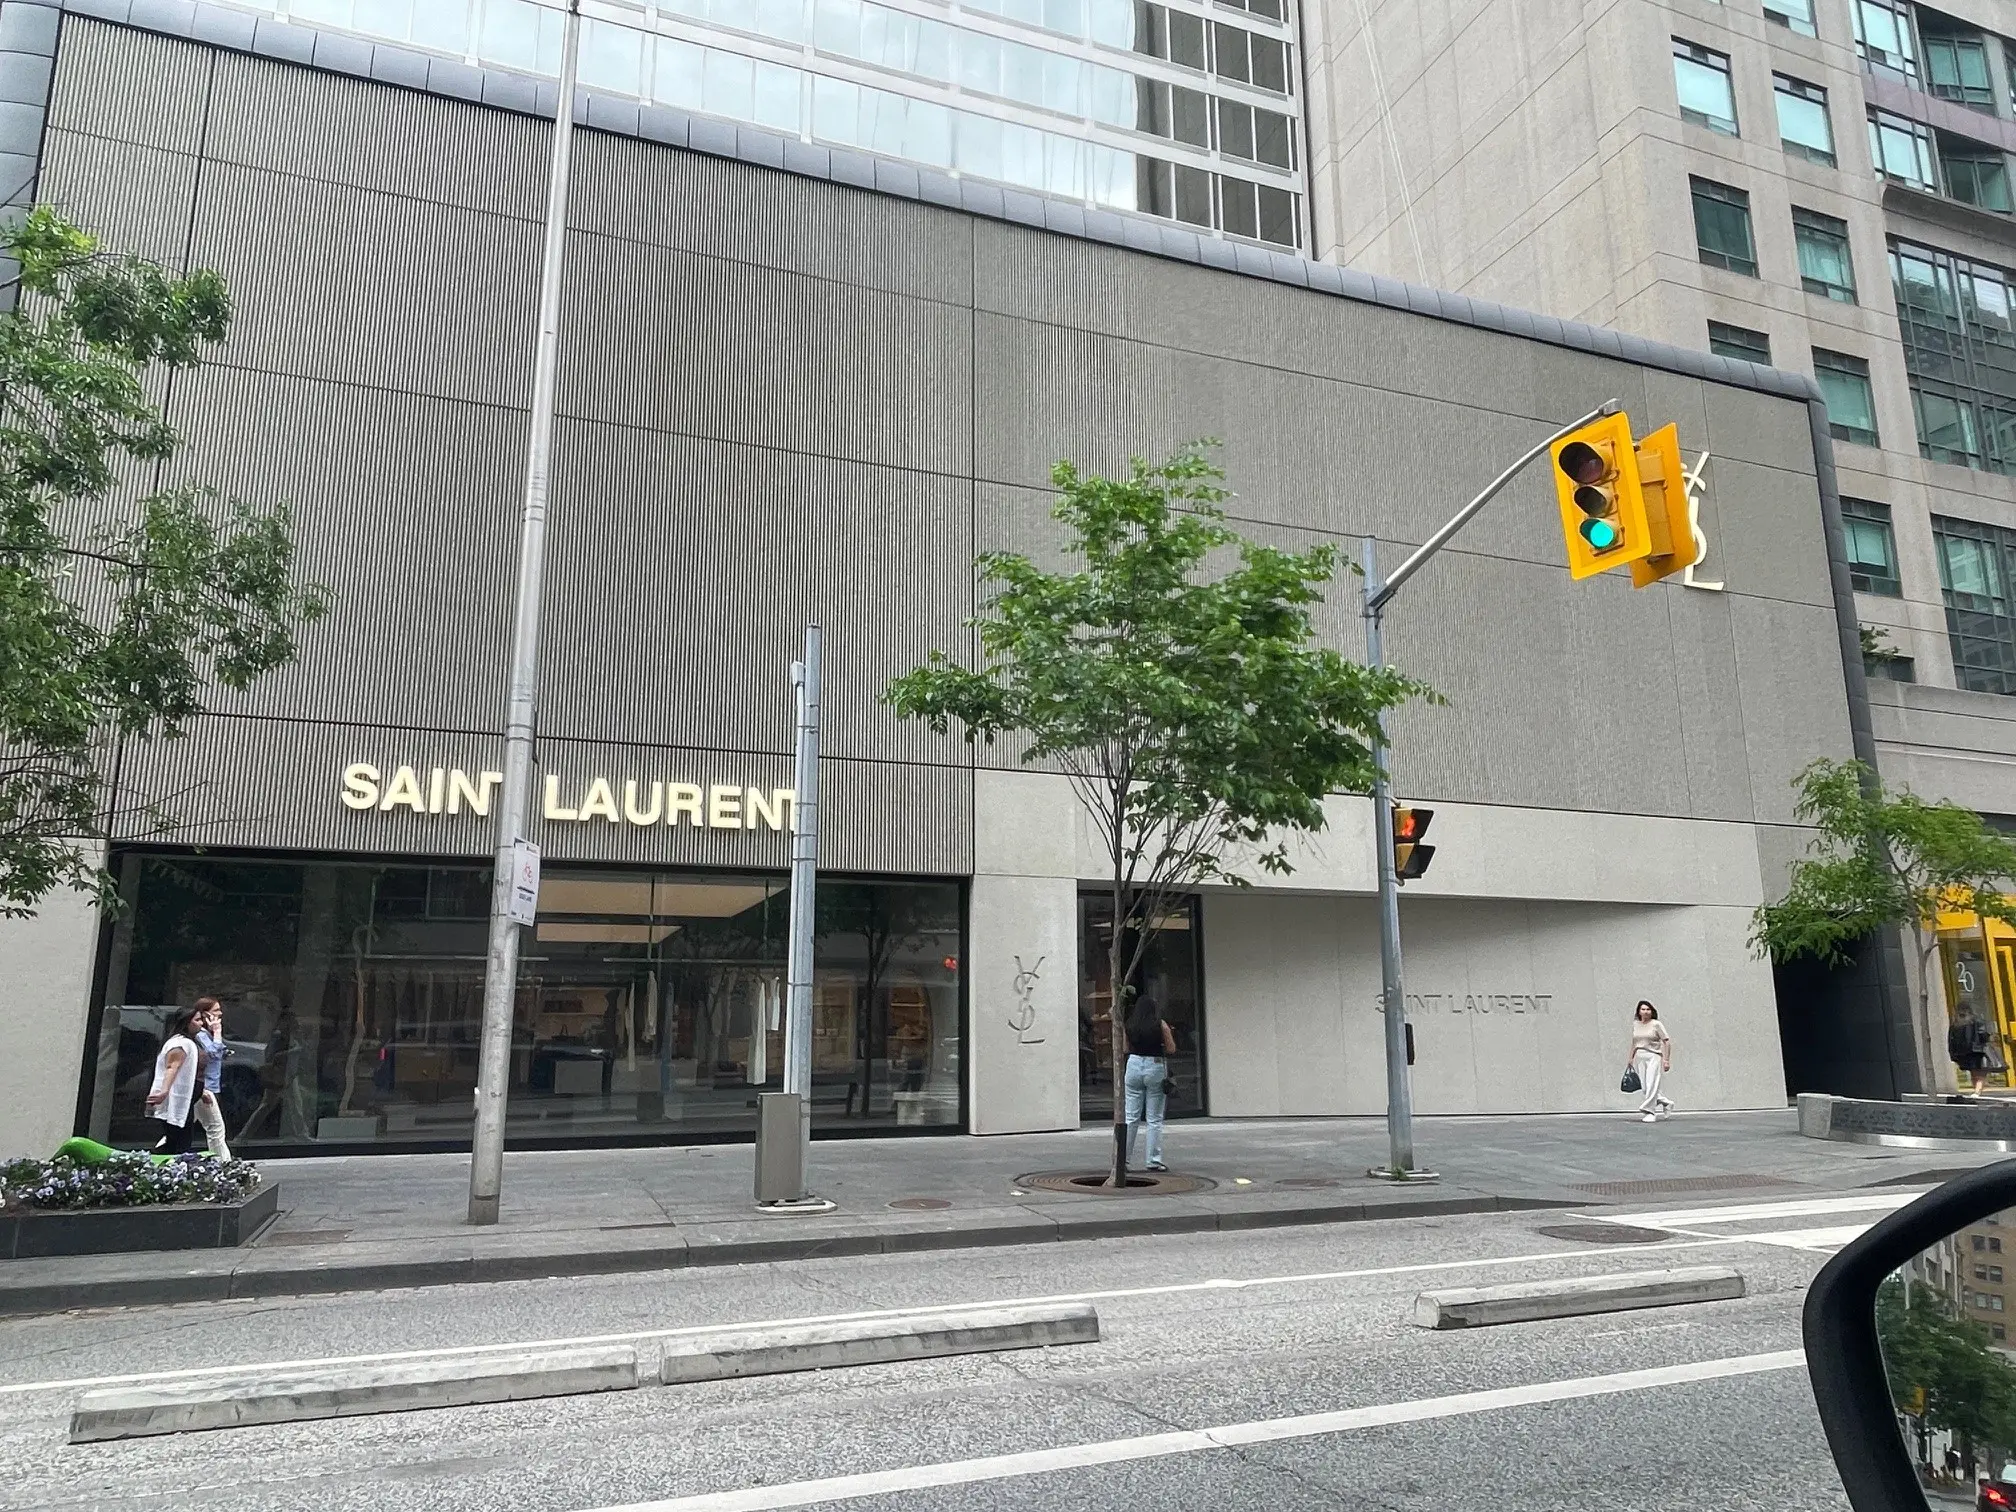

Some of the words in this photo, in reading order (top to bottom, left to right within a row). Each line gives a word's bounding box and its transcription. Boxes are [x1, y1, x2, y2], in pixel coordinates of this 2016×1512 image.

[1955, 961, 1975, 992] 20
[1008, 955, 1045, 1045] YSL
[1375, 993, 1441, 1014] SINT
[1448, 993, 1552, 1014] LAURENT
